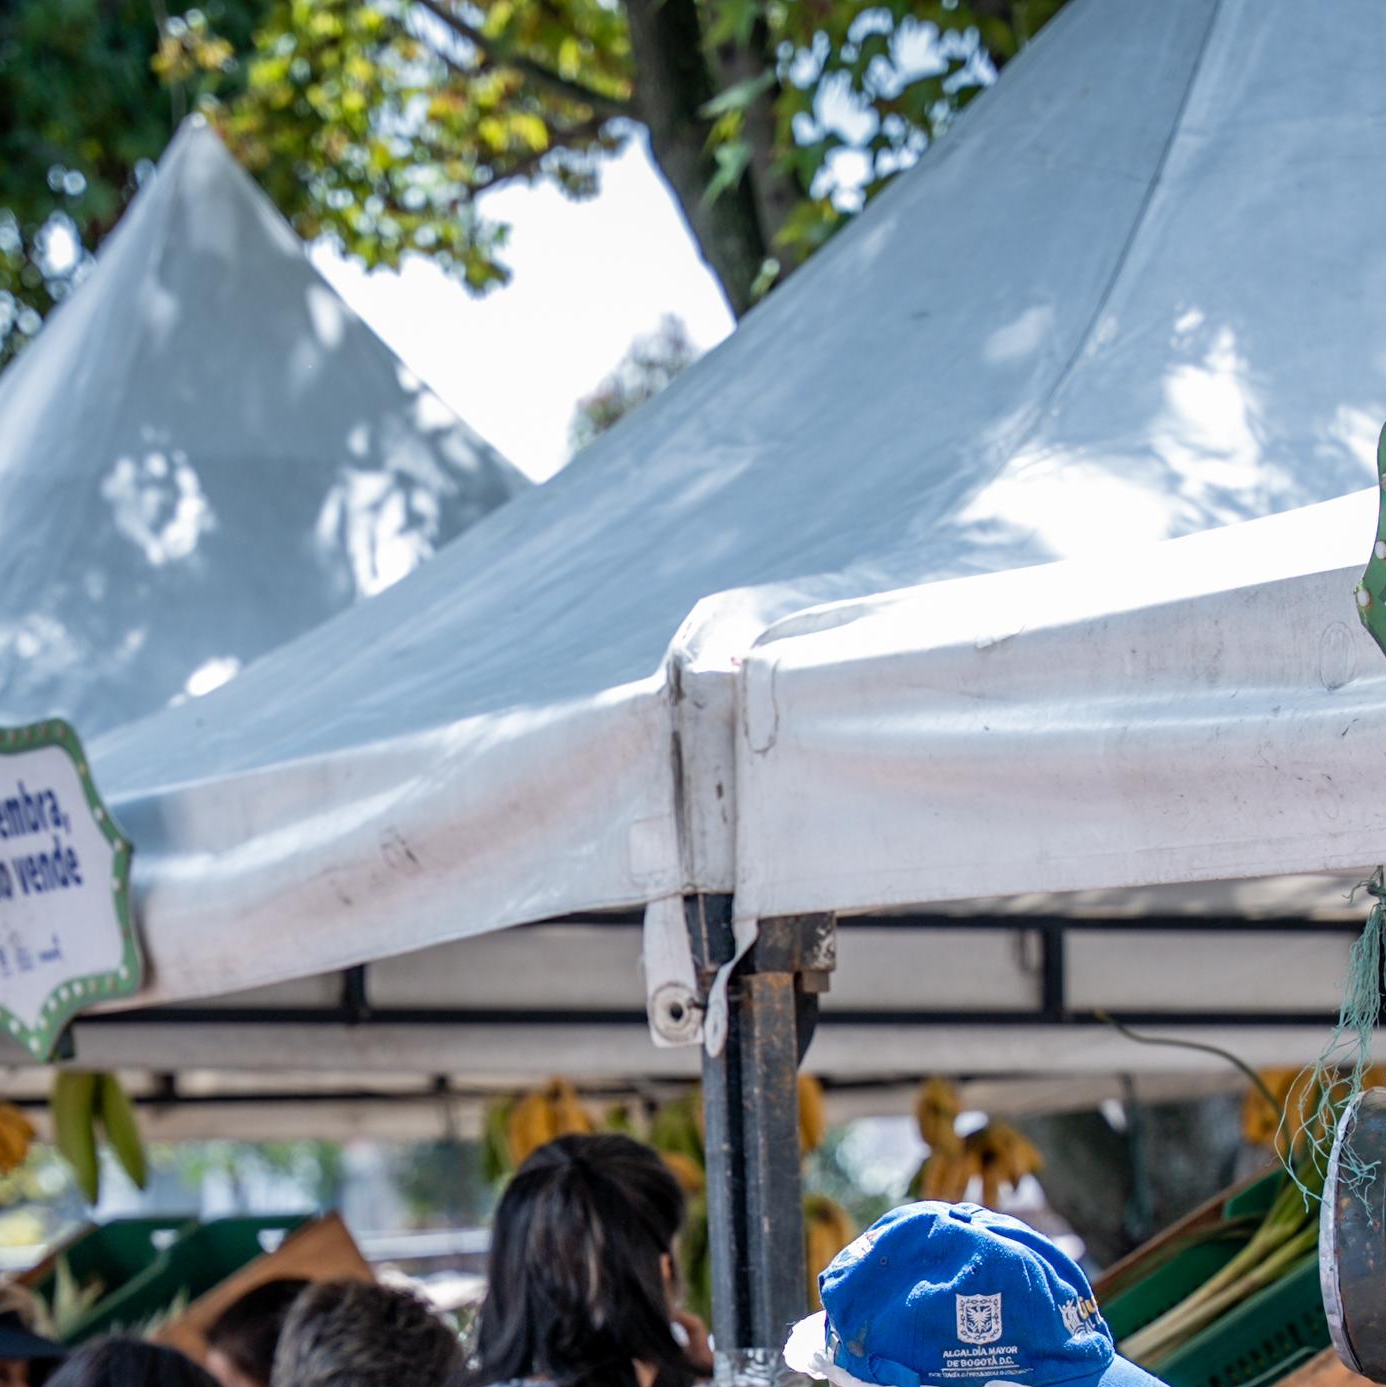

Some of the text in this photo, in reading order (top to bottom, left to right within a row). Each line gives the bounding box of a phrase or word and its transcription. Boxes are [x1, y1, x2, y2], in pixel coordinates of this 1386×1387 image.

[12, 834, 84, 895] vende
[943, 1345, 1018, 1358] ALCALDÍA MAYOR
[946, 1356, 1015, 1367] DE BOGOTÁ D.C.
